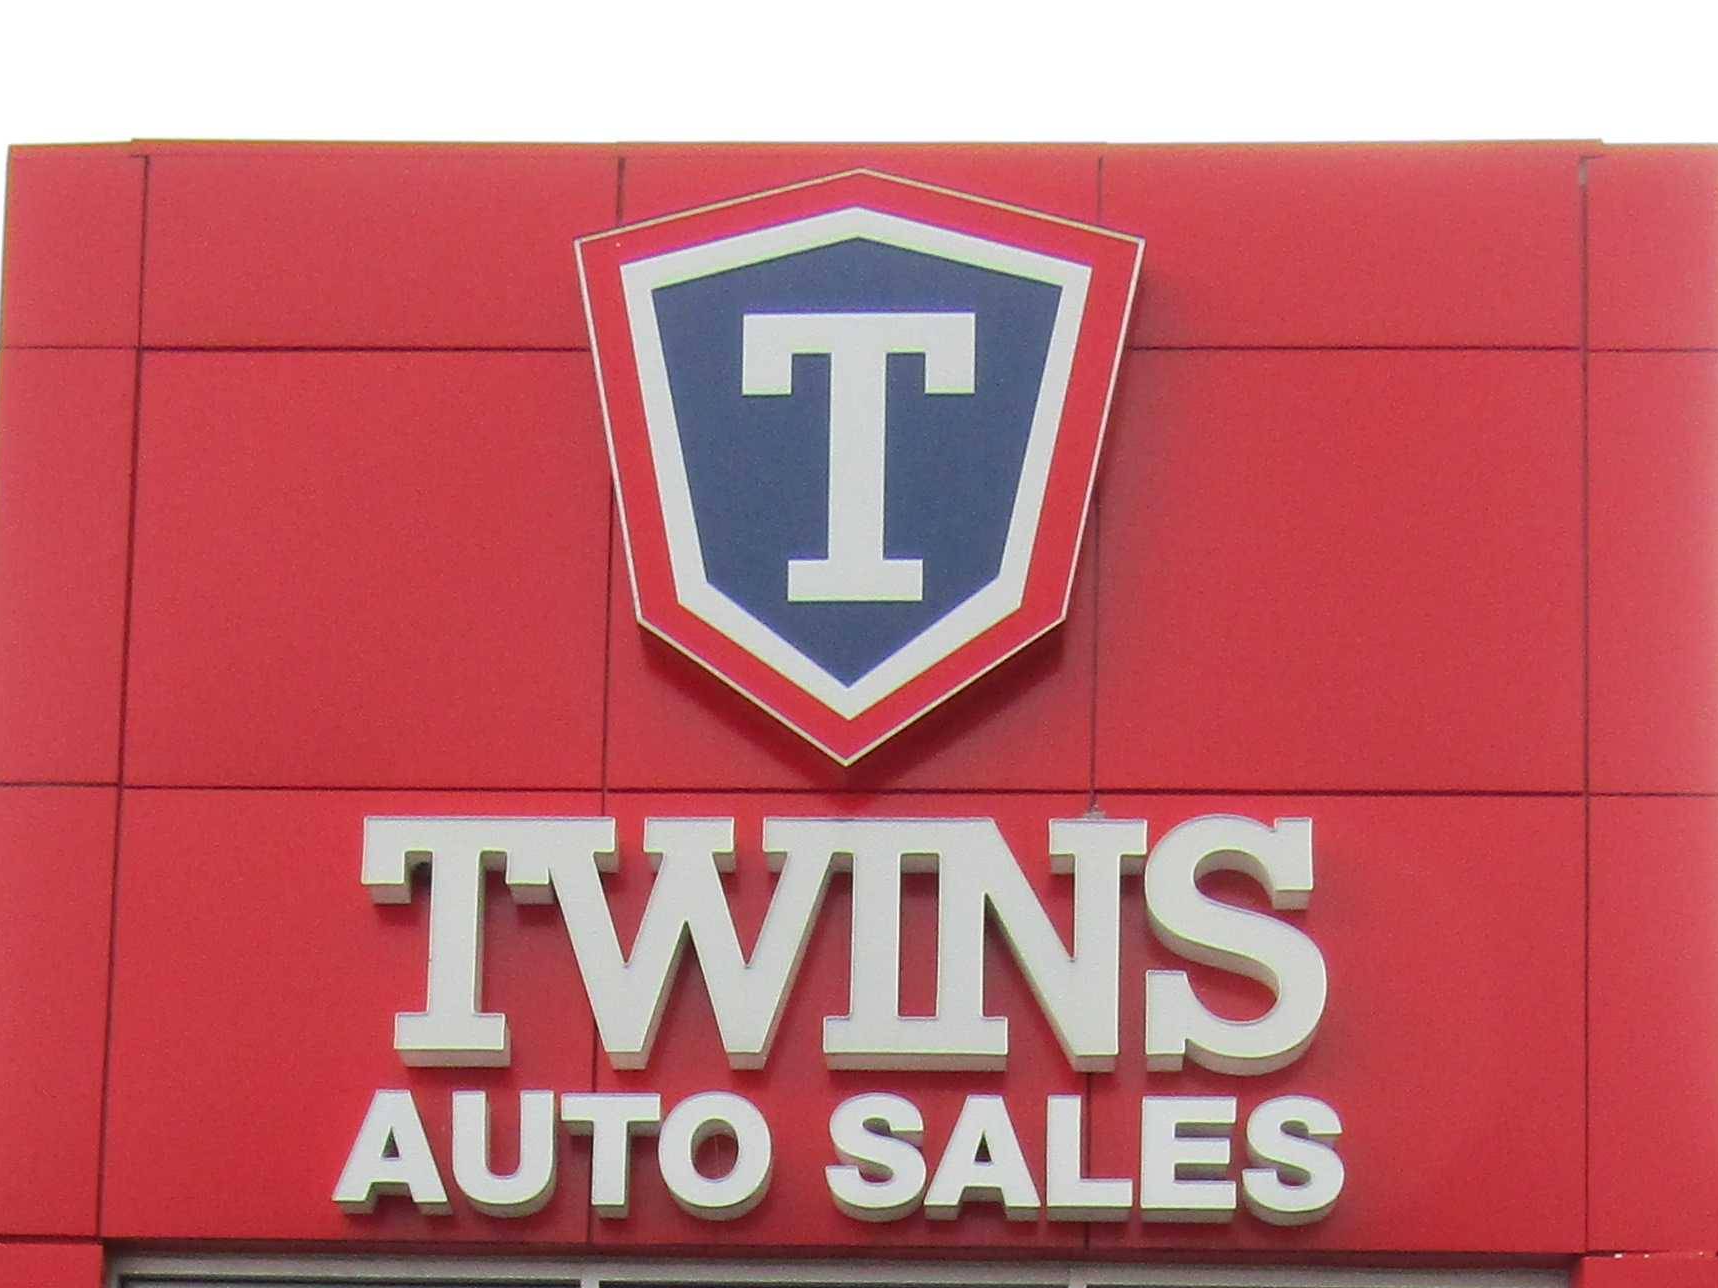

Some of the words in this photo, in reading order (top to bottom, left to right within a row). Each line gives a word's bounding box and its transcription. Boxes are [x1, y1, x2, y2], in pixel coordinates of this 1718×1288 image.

[741, 311, 976, 602] T
[362, 813, 1327, 1076] TWINS
[332, 1088, 774, 1222] AUTO
[824, 1092, 1345, 1226] SALES
